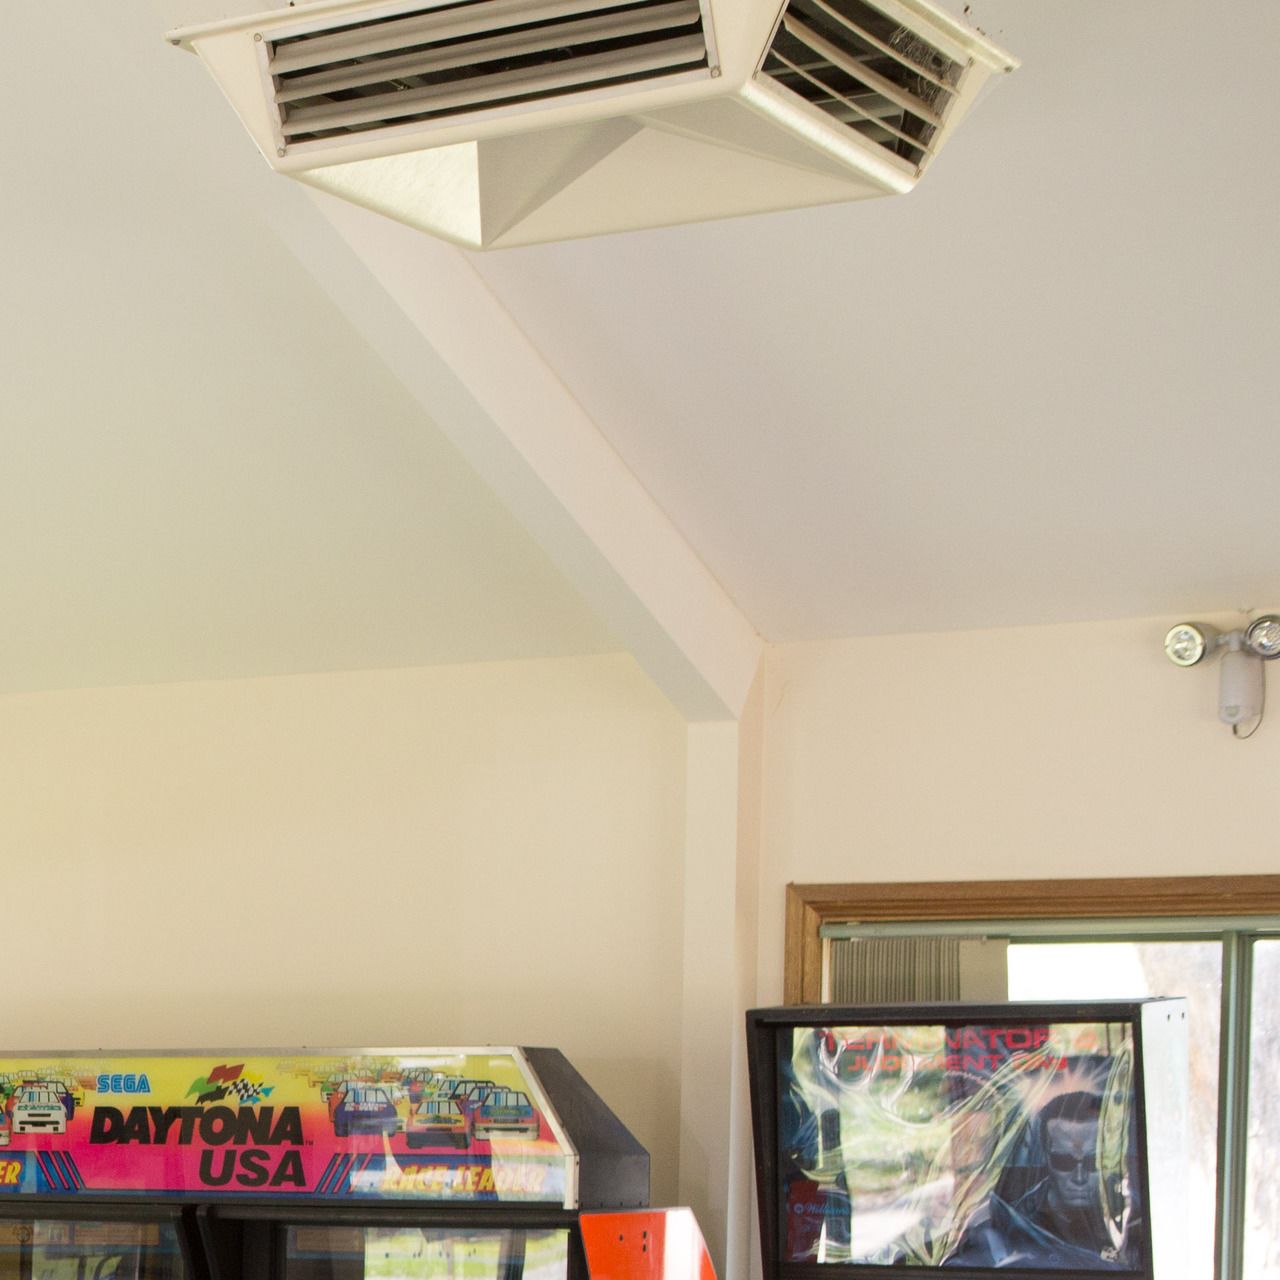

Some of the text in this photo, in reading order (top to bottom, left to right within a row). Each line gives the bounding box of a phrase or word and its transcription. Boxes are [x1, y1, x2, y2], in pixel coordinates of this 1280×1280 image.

[96, 1073, 151, 1094] SEGA
[89, 1105, 305, 1146] DAYTONA
[199, 1149, 307, 1188] USA
[380, 1164, 450, 1192] RACE
